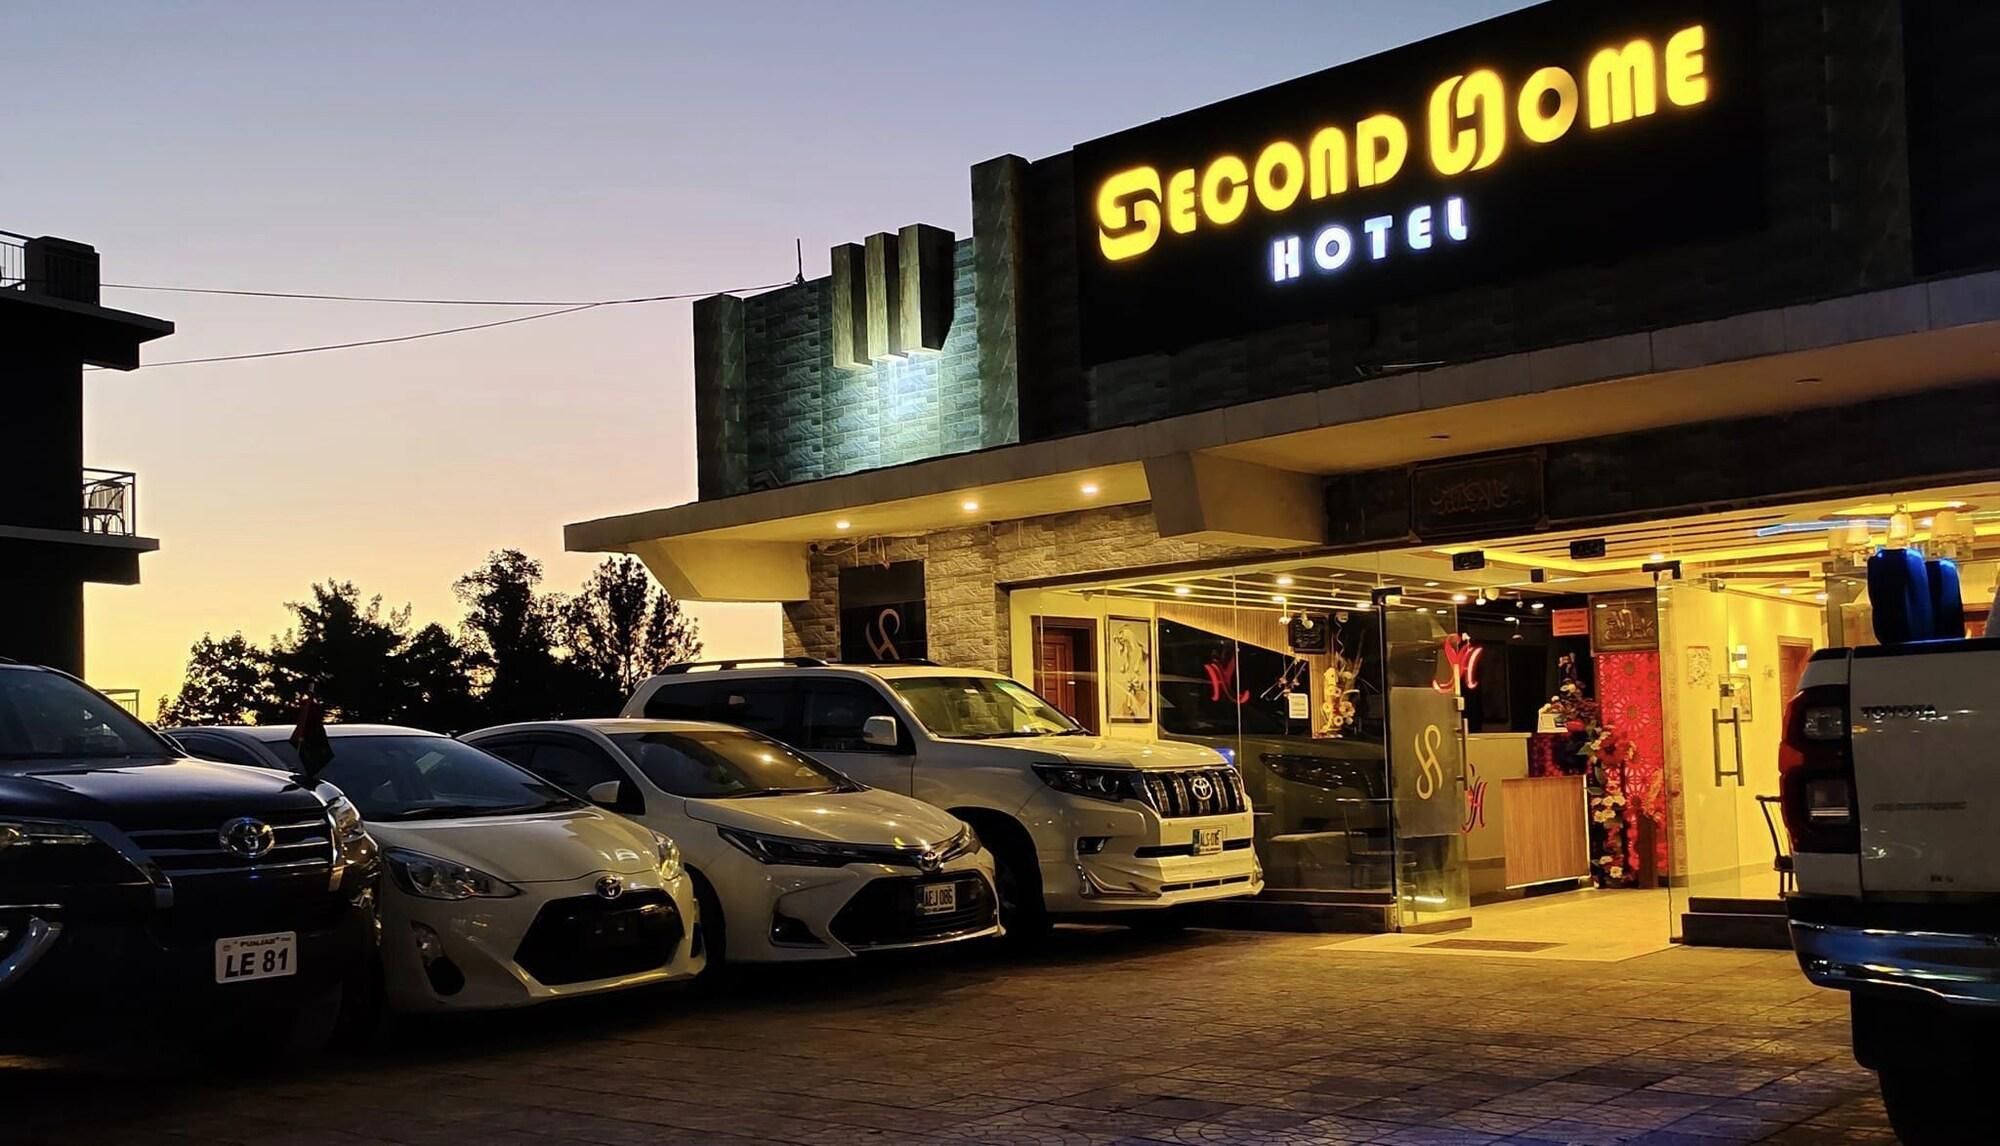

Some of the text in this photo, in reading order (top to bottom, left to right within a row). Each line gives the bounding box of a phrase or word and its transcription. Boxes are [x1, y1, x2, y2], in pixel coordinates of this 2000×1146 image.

[1097, 25, 1708, 261] SECOND HOME
[1271, 197, 1468, 283] HOTEL
[1861, 705, 1936, 720] TOYOTA
[240, 938, 276, 947] PUNJAB
[225, 947, 289, 978] LE 81
